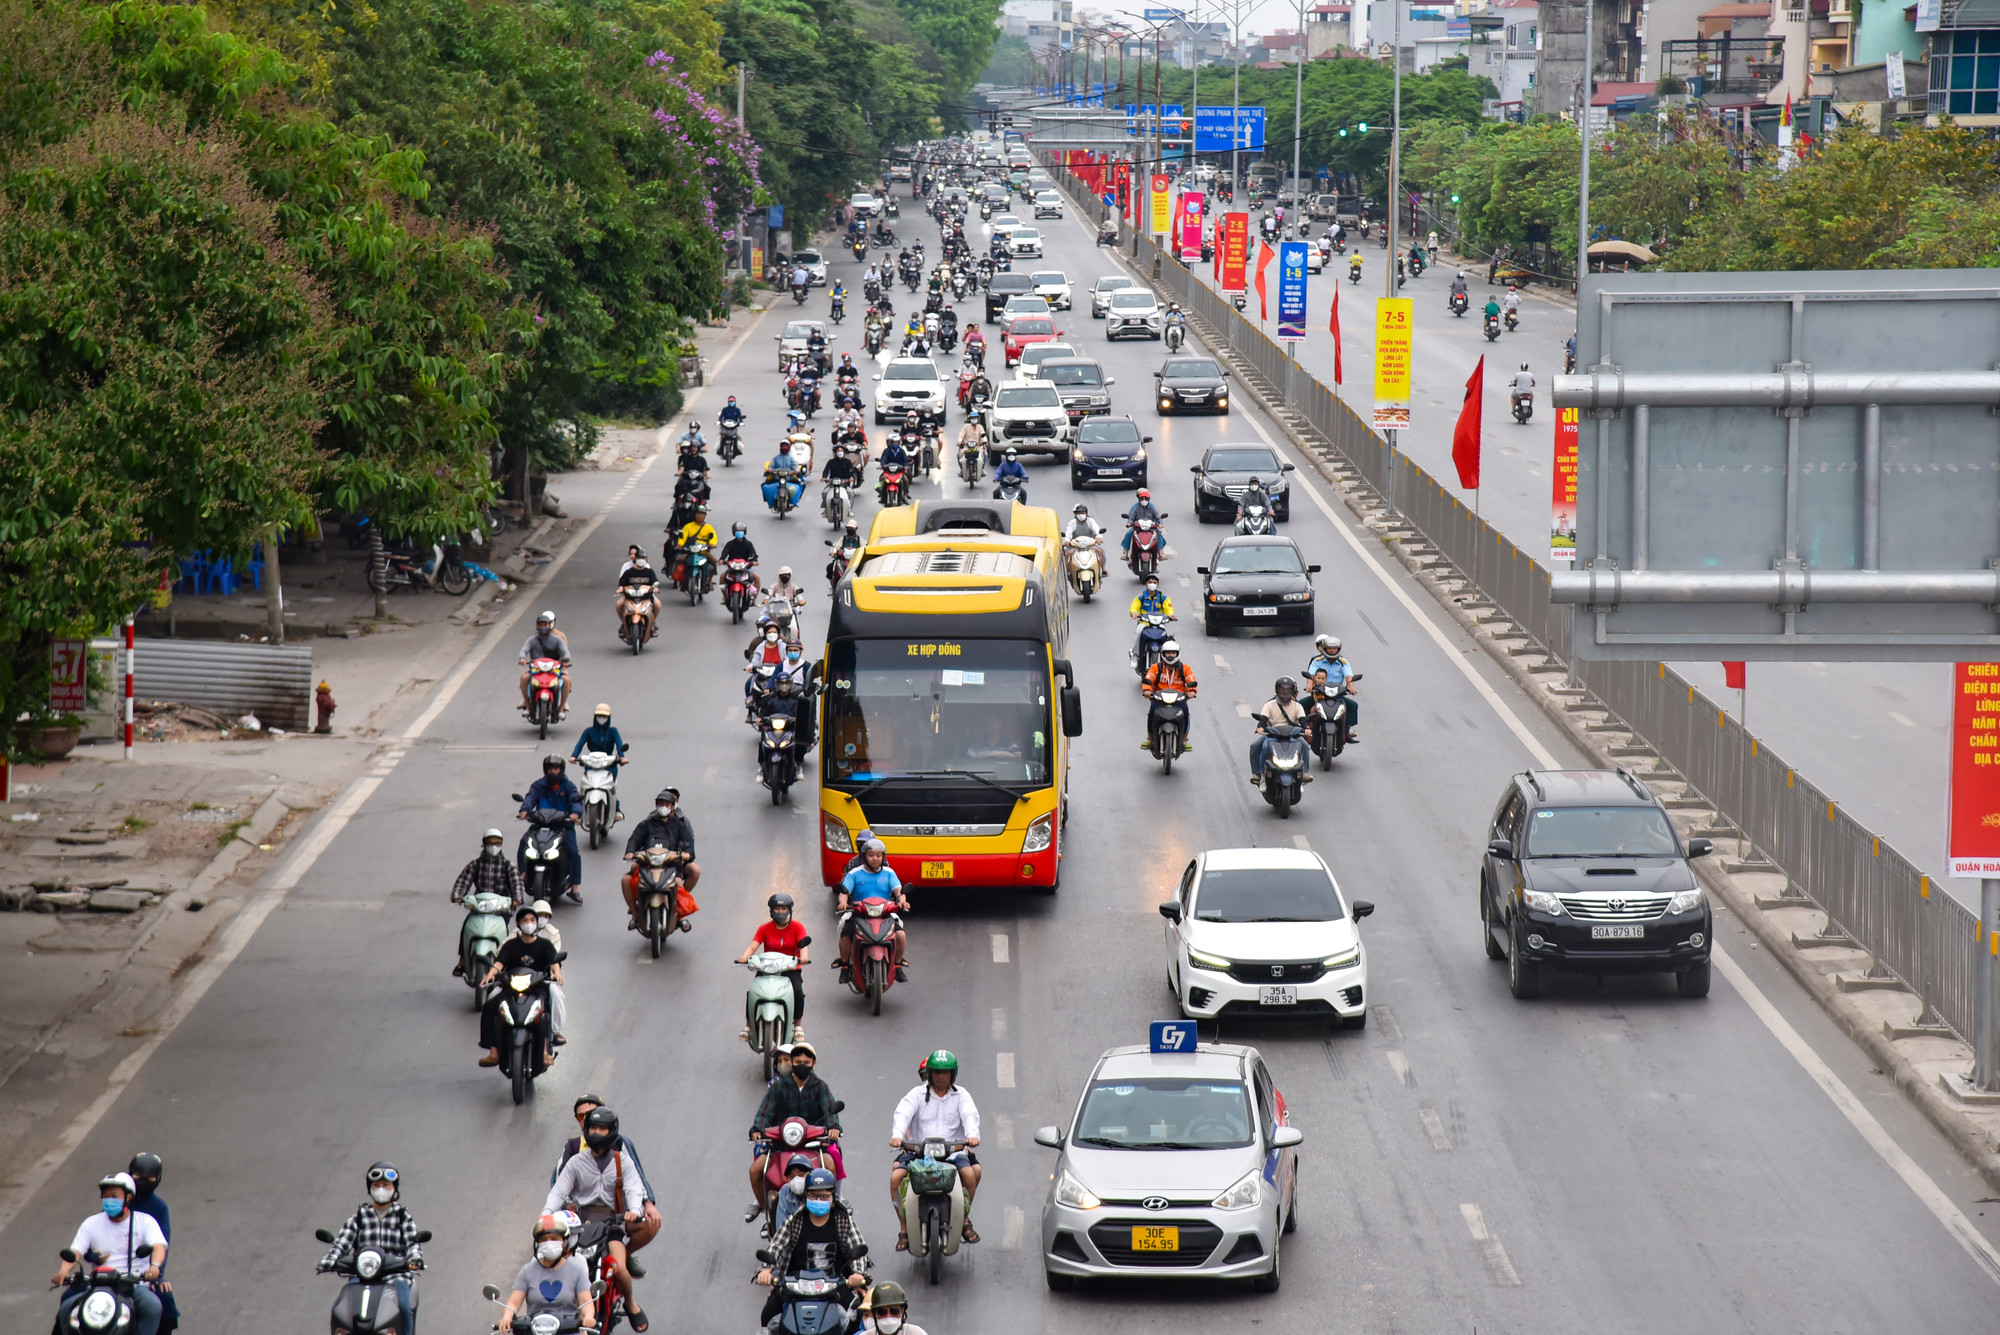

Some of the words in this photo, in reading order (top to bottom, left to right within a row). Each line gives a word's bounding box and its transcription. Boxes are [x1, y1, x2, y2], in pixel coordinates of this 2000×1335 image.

[1232, 109, 1250, 118] TỌNG
[1186, 214, 1200, 224] 1-5
[1286, 268, 1302, 277] 1-5
[1385, 312, 1404, 322] 7-5
[907, 644, 918, 656] XE
[920, 644, 936, 658] HỢP
[938, 642, 961, 656] ĐỒNG
[53, 642, 83, 683] 57
[1968, 662, 1998, 676] CHIẾN
[1964, 680, 1987, 696] ĐIỆN
[1976, 697, 2000, 712] LỪNG
[1972, 716, 1996, 729] NĂM
[1970, 731, 1997, 747] CHẤN
[1975, 753, 1991, 767] ĐỊA
[1956, 861, 1980, 873] QUẬN
[1270, 987, 1286, 995] 35A
[1162, 1025, 1186, 1050] G7
[1145, 1228, 1165, 1238] 30E
[1138, 1240, 1173, 1249] 154.95
